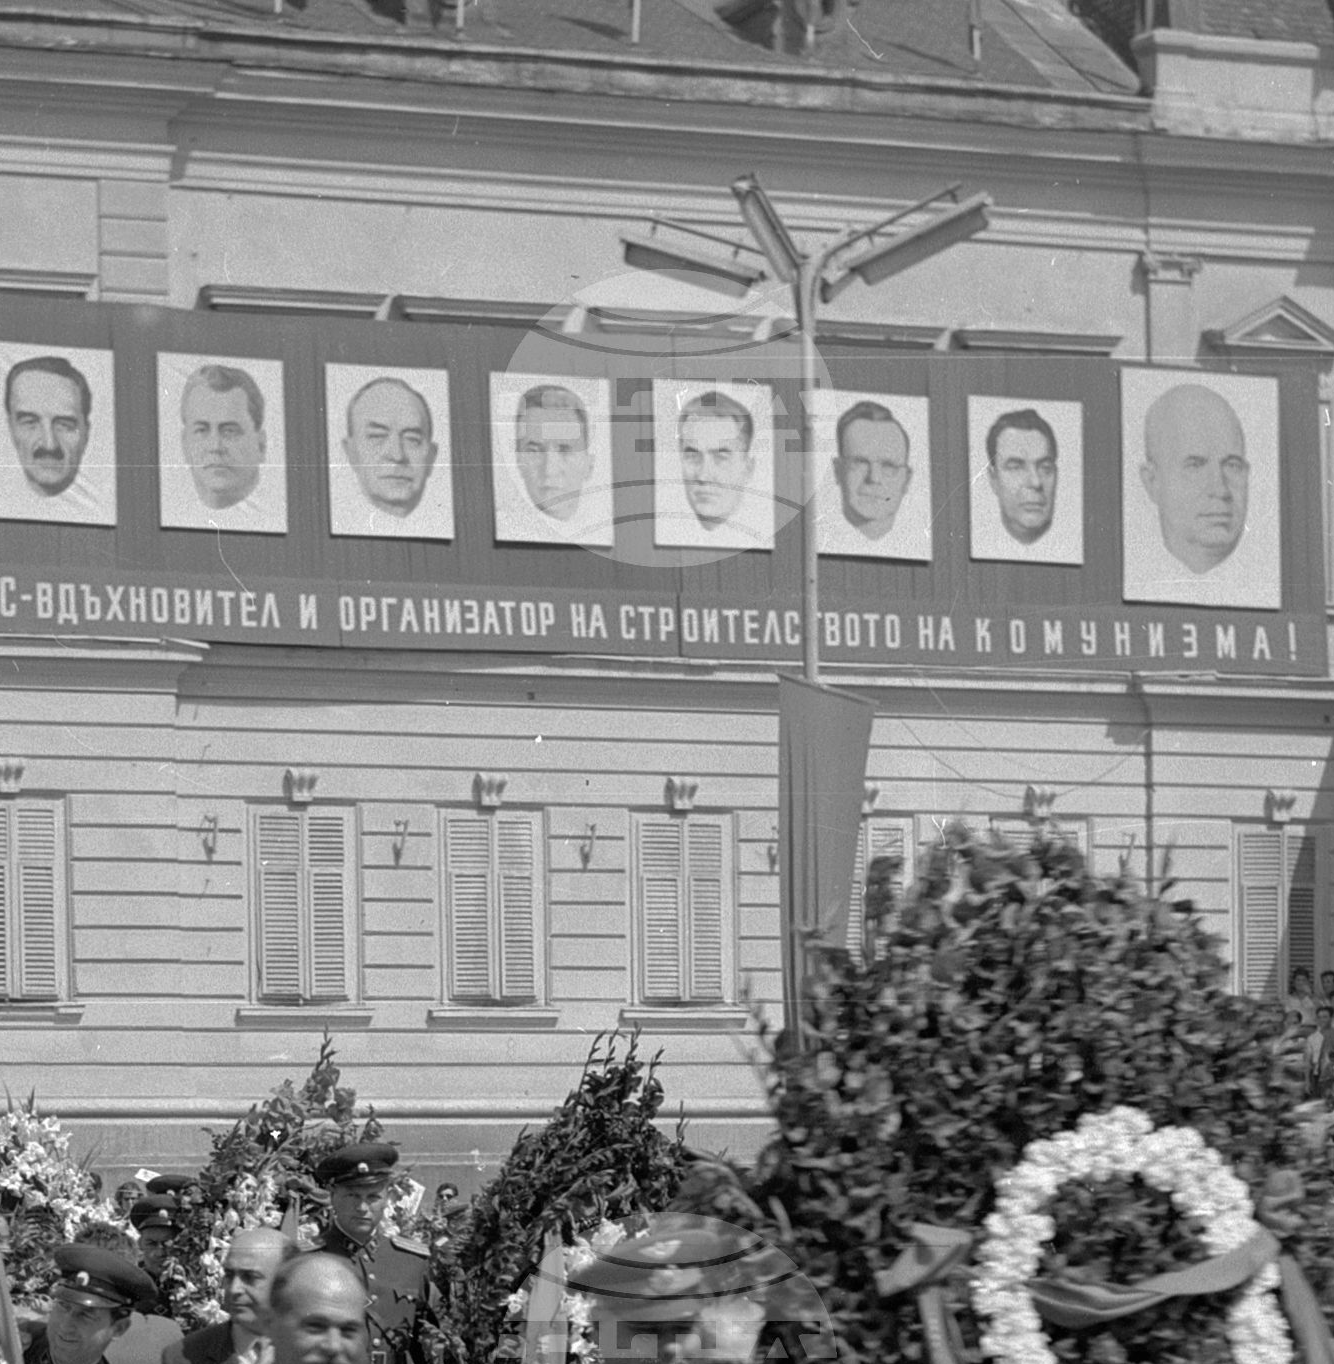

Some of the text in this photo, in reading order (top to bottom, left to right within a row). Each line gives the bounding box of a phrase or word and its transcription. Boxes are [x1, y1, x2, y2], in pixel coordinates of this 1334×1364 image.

[299, 594, 318, 630] И
[339, 595, 556, 637] ОРГАНИЗАТОР
[570, 601, 608, 640] НА
[918, 614, 956, 652] НА
[975, 615, 1299, 661] КОМУНИЗМА!
